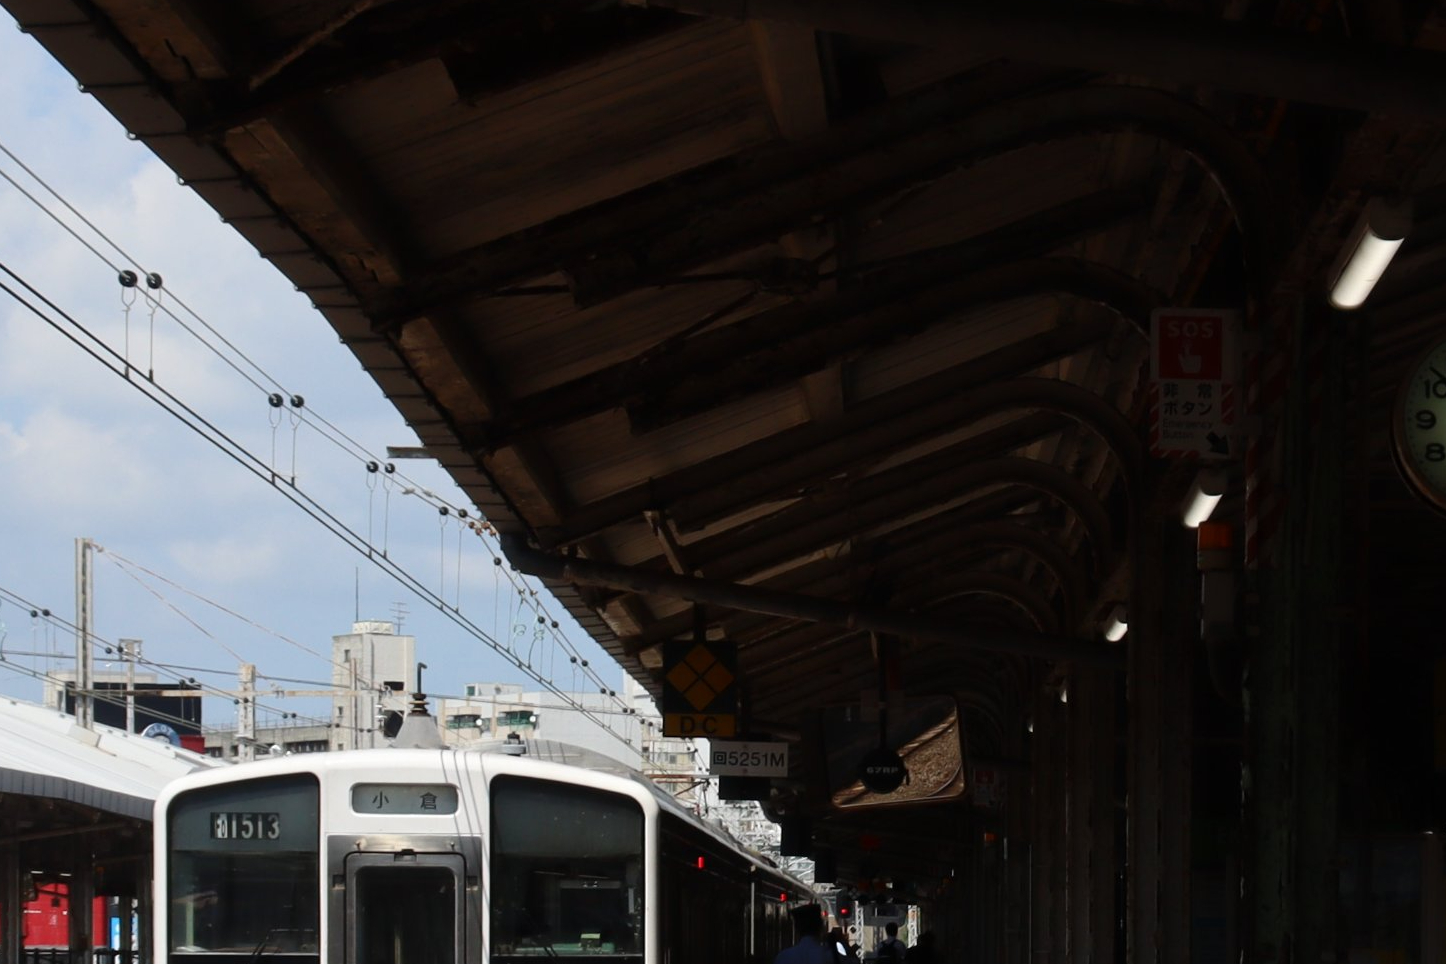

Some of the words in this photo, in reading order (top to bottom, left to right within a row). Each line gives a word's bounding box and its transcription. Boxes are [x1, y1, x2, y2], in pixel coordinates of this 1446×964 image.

[1167, 320, 1214, 338] SOS
[1163, 383, 1212, 398] 非常
[1163, 401, 1212, 416] ボタン
[1415, 409, 1437, 430] 9
[1424, 443, 1446, 462] 8
[371, 790, 438, 810] 小倉
